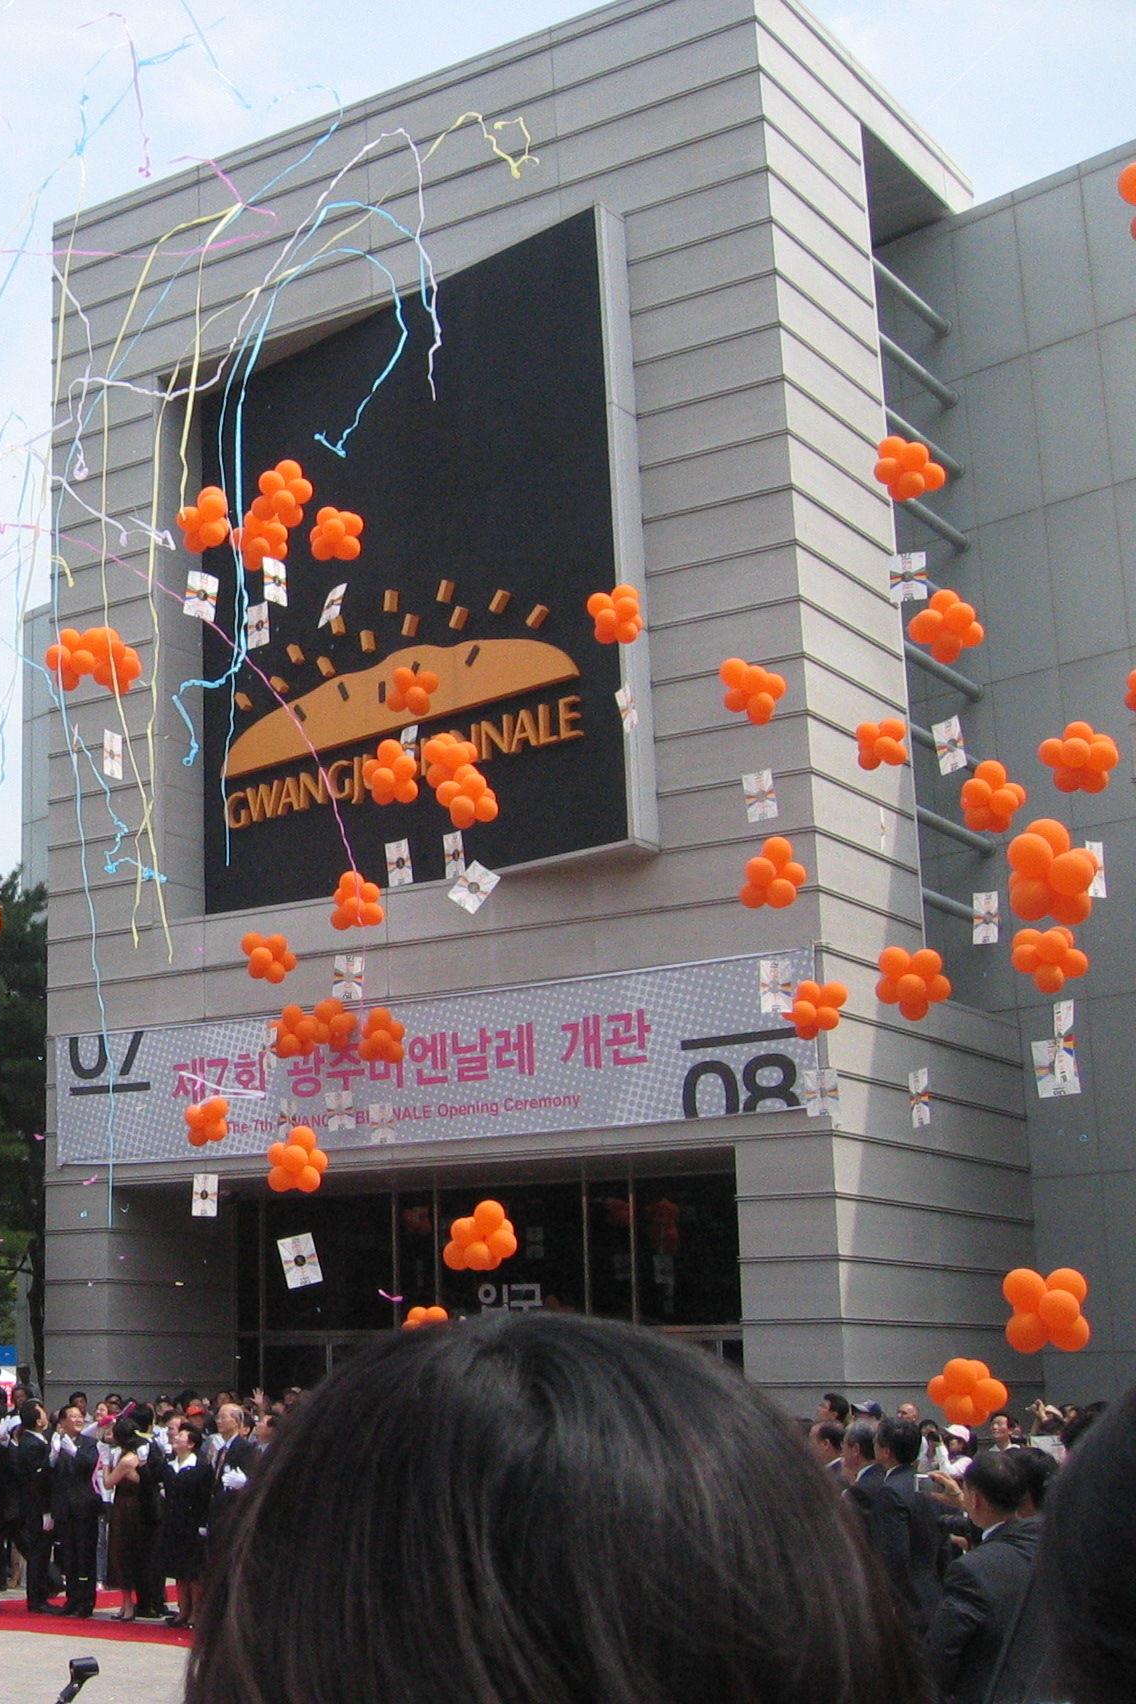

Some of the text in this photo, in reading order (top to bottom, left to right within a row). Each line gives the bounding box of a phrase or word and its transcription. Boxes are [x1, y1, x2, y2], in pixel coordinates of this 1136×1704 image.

[171, 1051, 267, 1104] 제7회
[560, 1008, 651, 1070] 개관
[226, 1120, 248, 1134] The
[253, 1118, 273, 1132] 7th
[356, 1104, 432, 1125] BINALE
[438, 1100, 499, 1119] Opening
[503, 1094, 581, 1112] Ceremony
